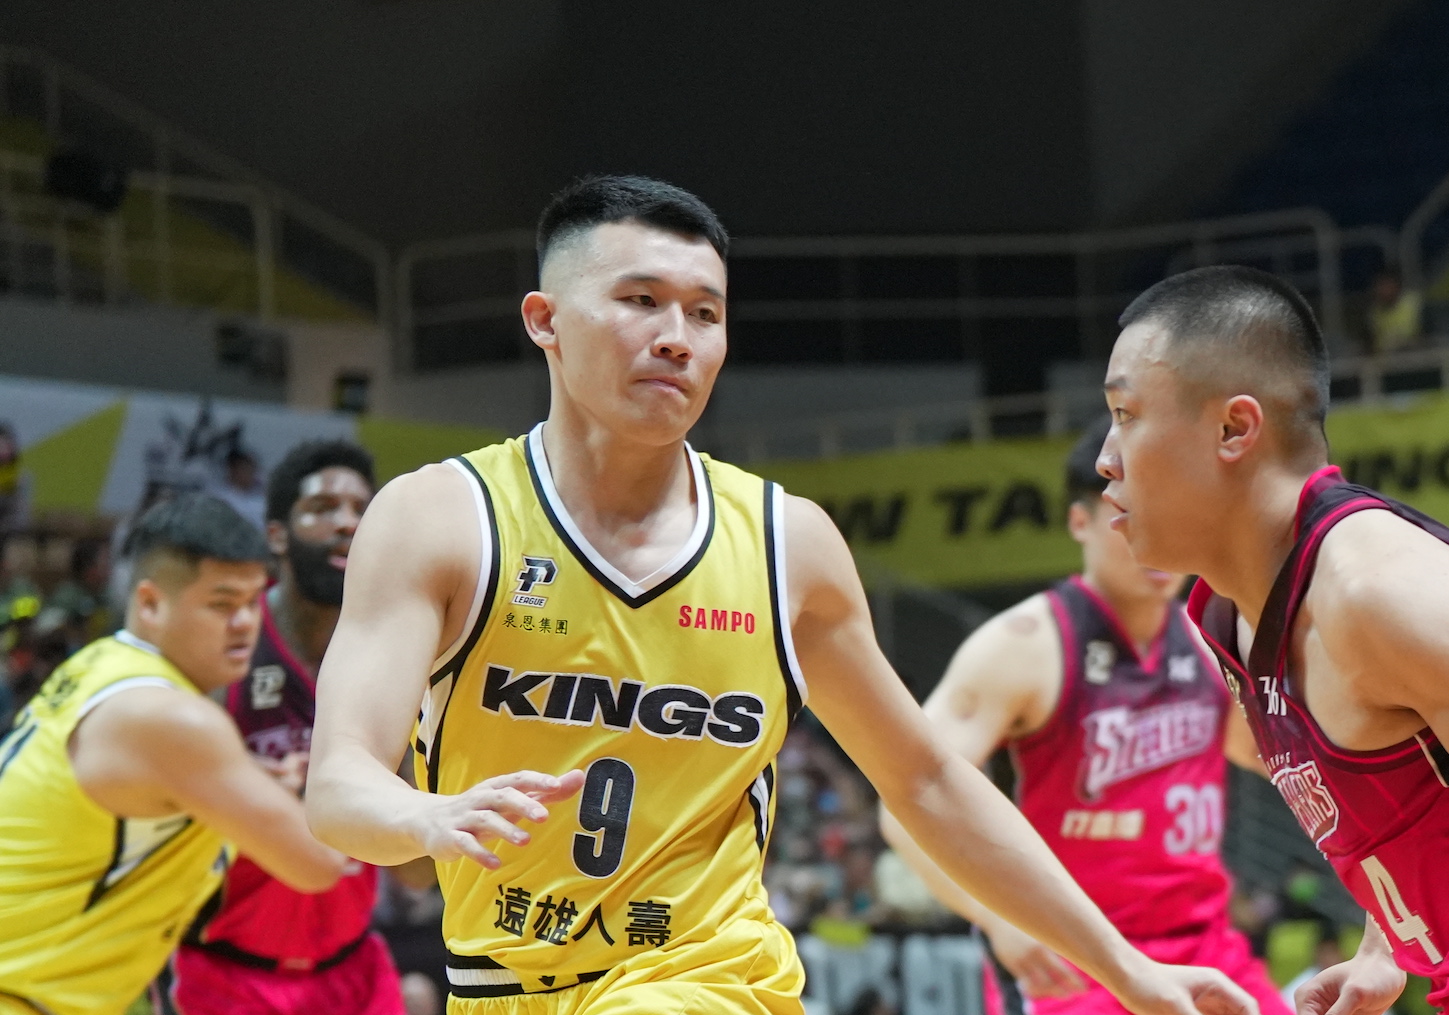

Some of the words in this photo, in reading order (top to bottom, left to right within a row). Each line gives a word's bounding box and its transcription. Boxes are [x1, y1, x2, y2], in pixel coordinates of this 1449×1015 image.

[502, 612, 569, 635] 泉恩集團
[513, 594, 546, 607] LEAGUE
[677, 604, 756, 635] SAMPO
[480, 663, 766, 748] KINGS
[572, 757, 636, 879] 9
[1163, 783, 1223, 857] 30
[493, 883, 672, 948] 遠雄人壽
[1359, 855, 1444, 965] 4
